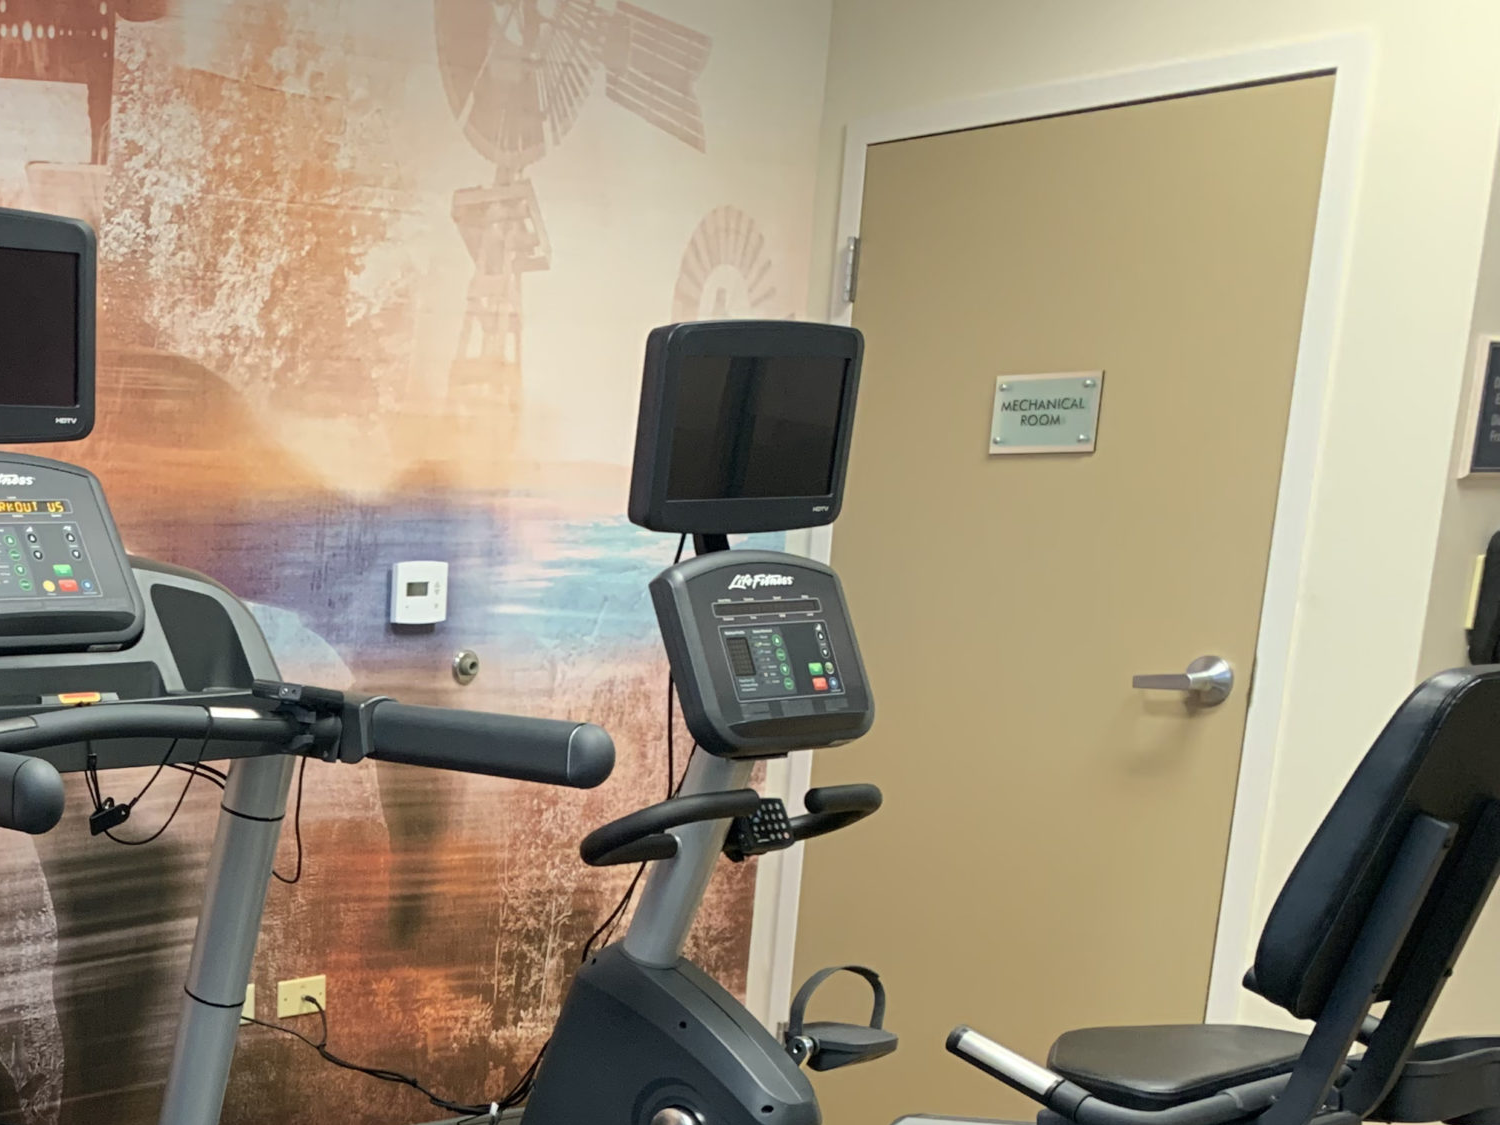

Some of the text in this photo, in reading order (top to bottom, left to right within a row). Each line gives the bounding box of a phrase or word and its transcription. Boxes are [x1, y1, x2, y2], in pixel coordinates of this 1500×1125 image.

[1000, 397, 1086, 412] MECHANICAL
[54, 416, 78, 425] HDTV
[1020, 413, 1061, 426] ROOM
[46, 501, 64, 513] US
